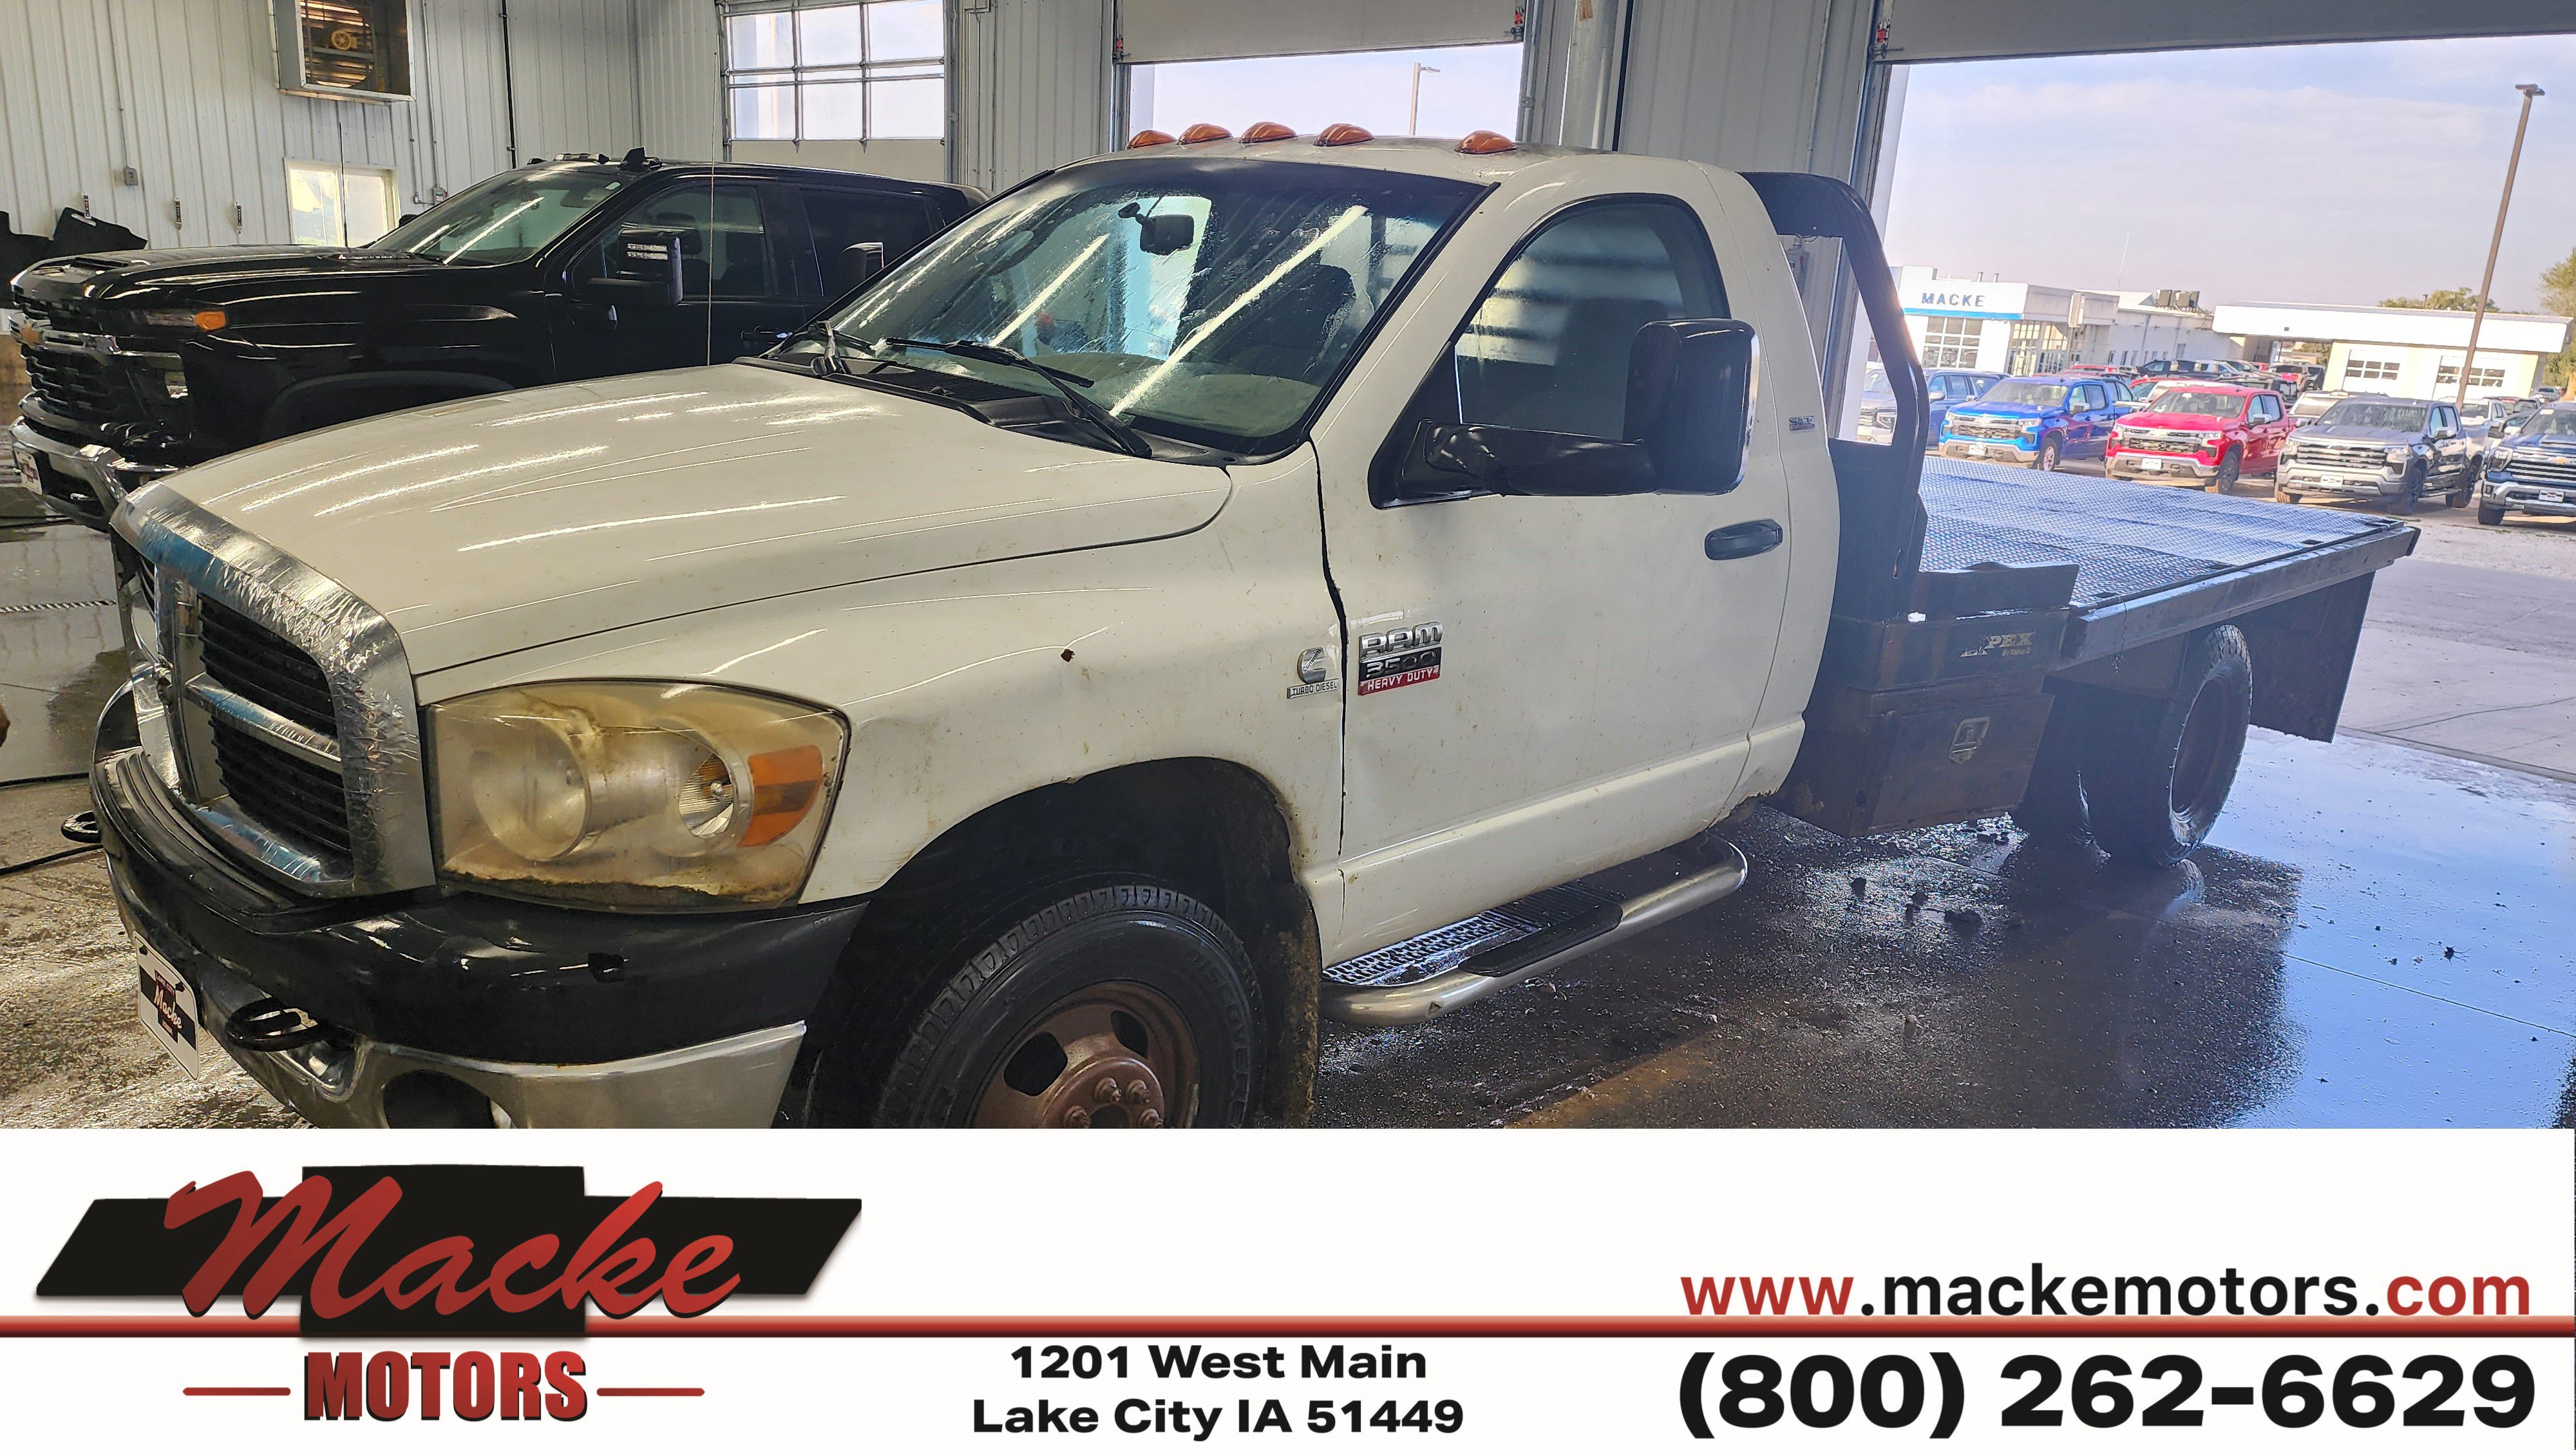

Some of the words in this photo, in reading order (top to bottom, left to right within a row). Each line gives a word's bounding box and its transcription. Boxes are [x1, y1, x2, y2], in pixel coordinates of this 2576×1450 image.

[1922, 293, 1985, 306] MACKE
[1359, 621, 1443, 661] RAM
[1302, 647, 1322, 672] Cummins
[1366, 650, 1437, 679] 3500
[1292, 684, 1313, 695] TURBO
[1315, 680, 1338, 692] DIESEL
[1367, 675, 1403, 691] HEAVY
[1406, 668, 1434, 683] DUTY
[154, 984, 182, 1029] Macke
